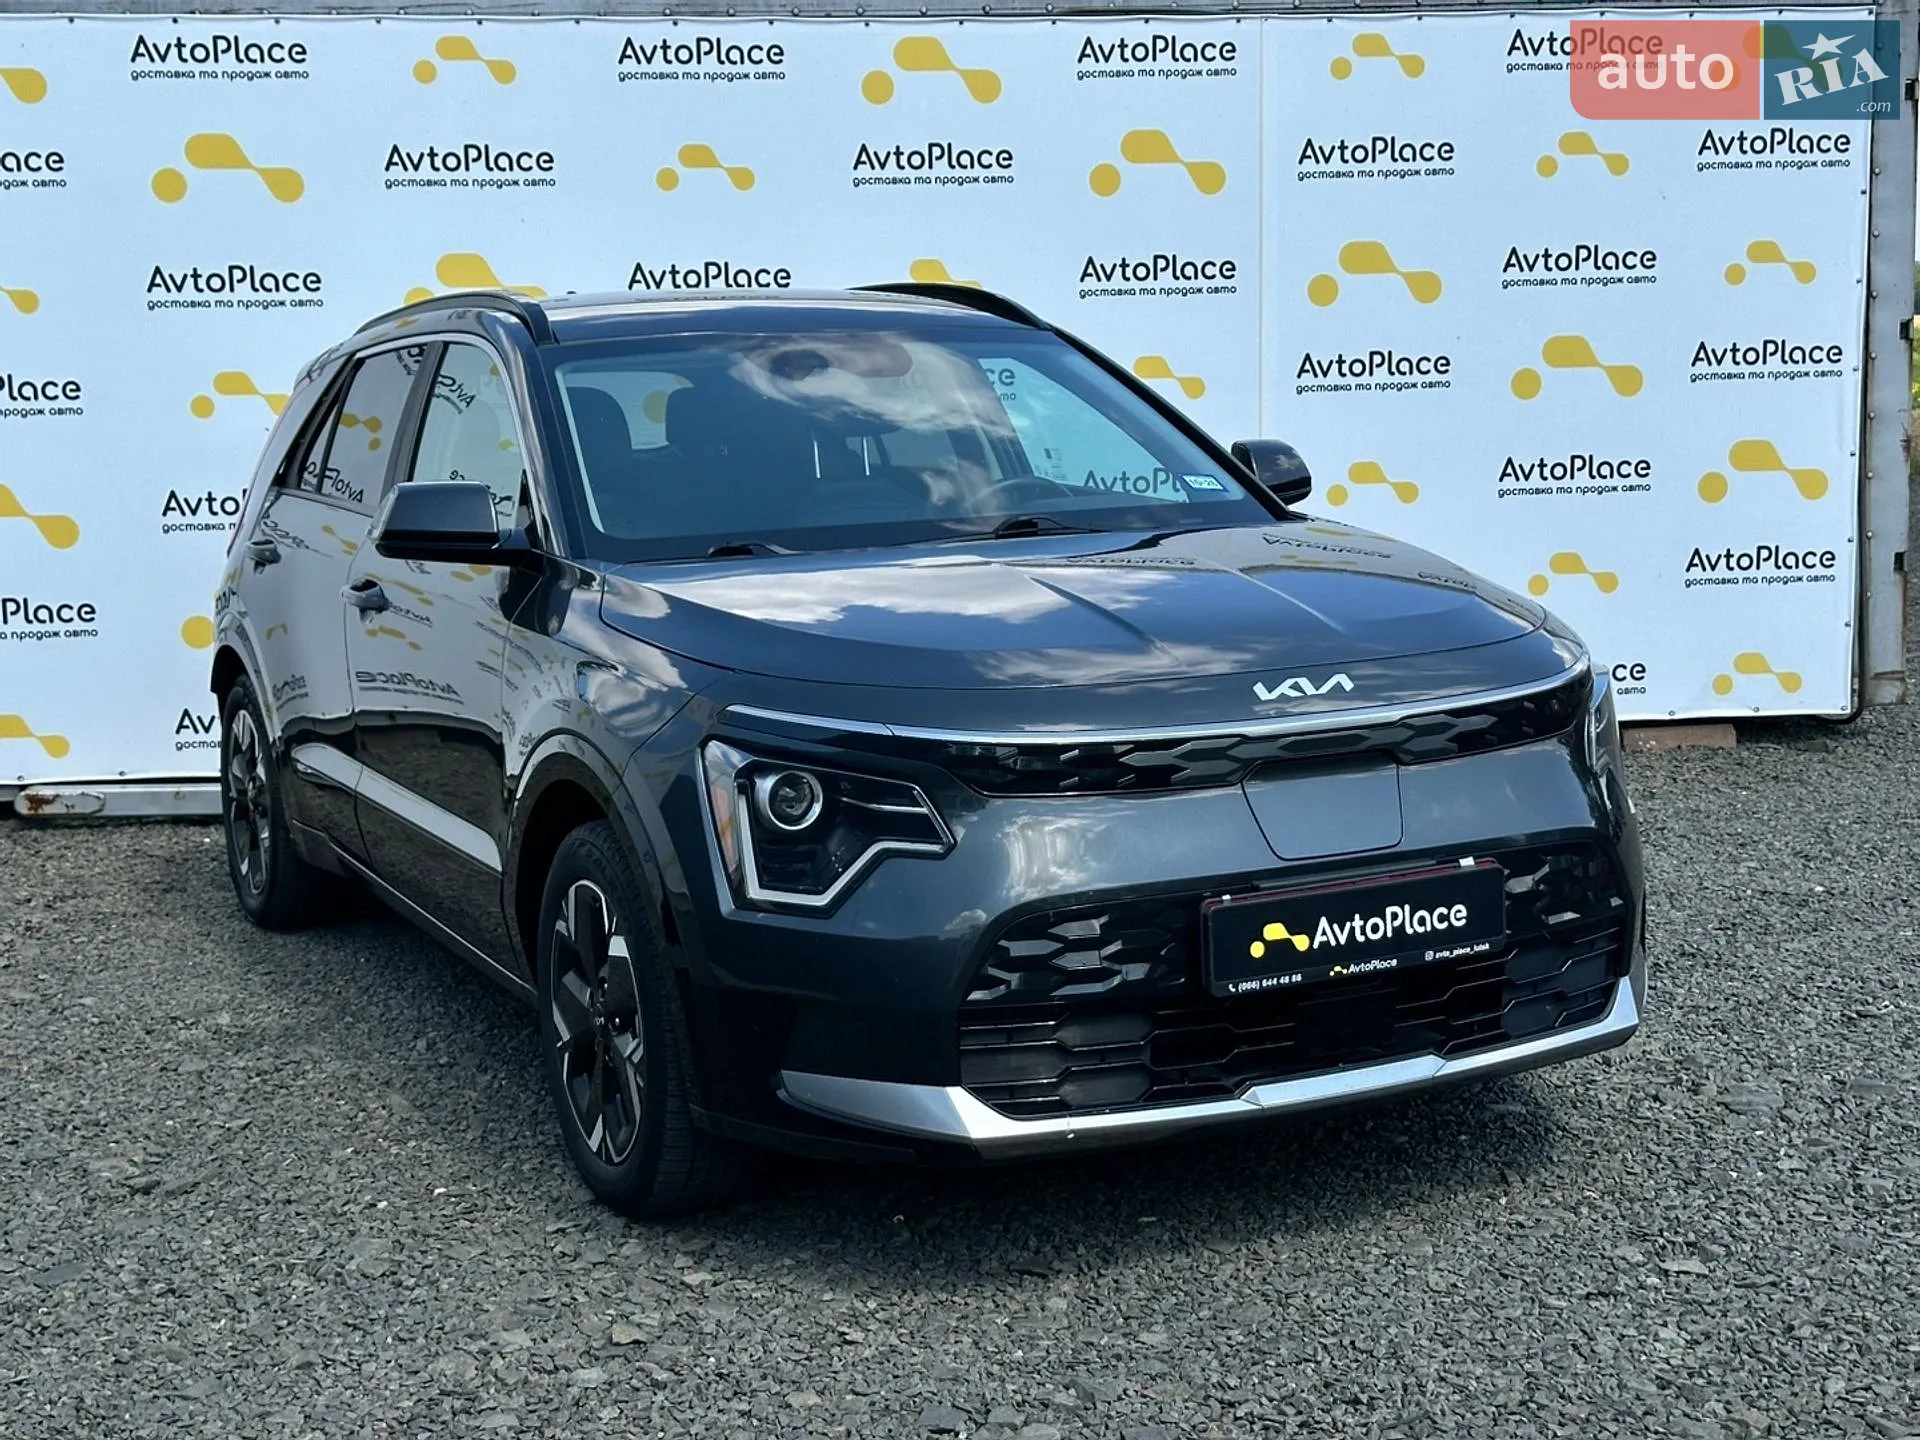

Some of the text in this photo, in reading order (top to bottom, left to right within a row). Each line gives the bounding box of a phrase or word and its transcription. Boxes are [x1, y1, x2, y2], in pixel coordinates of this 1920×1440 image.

[131, 35, 307, 63] AvtoPlace
[618, 37, 784, 65] AvtoPlace
[1078, 35, 1236, 64] AvtoPlace
[1507, 27, 1663, 56] AvtoPlace
[131, 70, 309, 82] доставка та продаж авто
[618, 71, 785, 83] доставка та продаж авто
[1077, 68, 1237, 81] доставка та продаж авто
[1506, 62, 1563, 73] доставка
[1298, 136, 1454, 165] AvtoPlace
[1698, 128, 1850, 156] AvtoPlace
[385, 144, 554, 172] AvtoPlace
[853, 142, 1013, 170] AvtoPlace
[1697, 159, 1850, 172] доставка та продаж авто
[32, 179, 67, 188] авто
[384, 179, 556, 190] доставка та продаж авто
[853, 176, 1014, 188] доставка та продаж авто
[1298, 168, 1454, 181] доставка та продаж авто
[1080, 254, 1236, 282] AvtoPlace
[1503, 245, 1656, 273] AvtoPlace
[147, 265, 321, 293] AvtoPlace
[628, 261, 791, 290] AvtoPlace
[1502, 278, 1558, 289] доставка
[1580, 277, 1624, 287] продаж
[1626, 276, 1657, 284] авто
[1079, 286, 1237, 299] доставка та продаж авто
[147, 299, 323, 311] доставка та продаж авто
[1691, 339, 1842, 367] AvtoPlace
[1297, 350, 1450, 379] AvtoPlace
[1690, 370, 1843, 383] доставка та продаж авто
[1296, 380, 1451, 395] доставка та продаж авто
[49, 407, 83, 416] авто
[1499, 454, 1651, 482] AvtoPlace
[1498, 487, 1553, 498] доставка
[1575, 485, 1619, 496] продаж
[1621, 484, 1651, 492] авто
[162, 489, 247, 517] Avto
[162, 523, 225, 534] доставка
[1686, 545, 1835, 573] AvtoPlace
[1684, 577, 1739, 589] доставка
[1742, 576, 1758, 584] та
[1761, 575, 1804, 586] продаж
[2, 598, 96, 625] Place
[11, 630, 61, 642] продаж
[64, 629, 98, 638] авто
[1253, 673, 1354, 701] KIA
[1313, 904, 1467, 949] AvtoPlace
[1348, 959, 1398, 974] AvtoPlace
